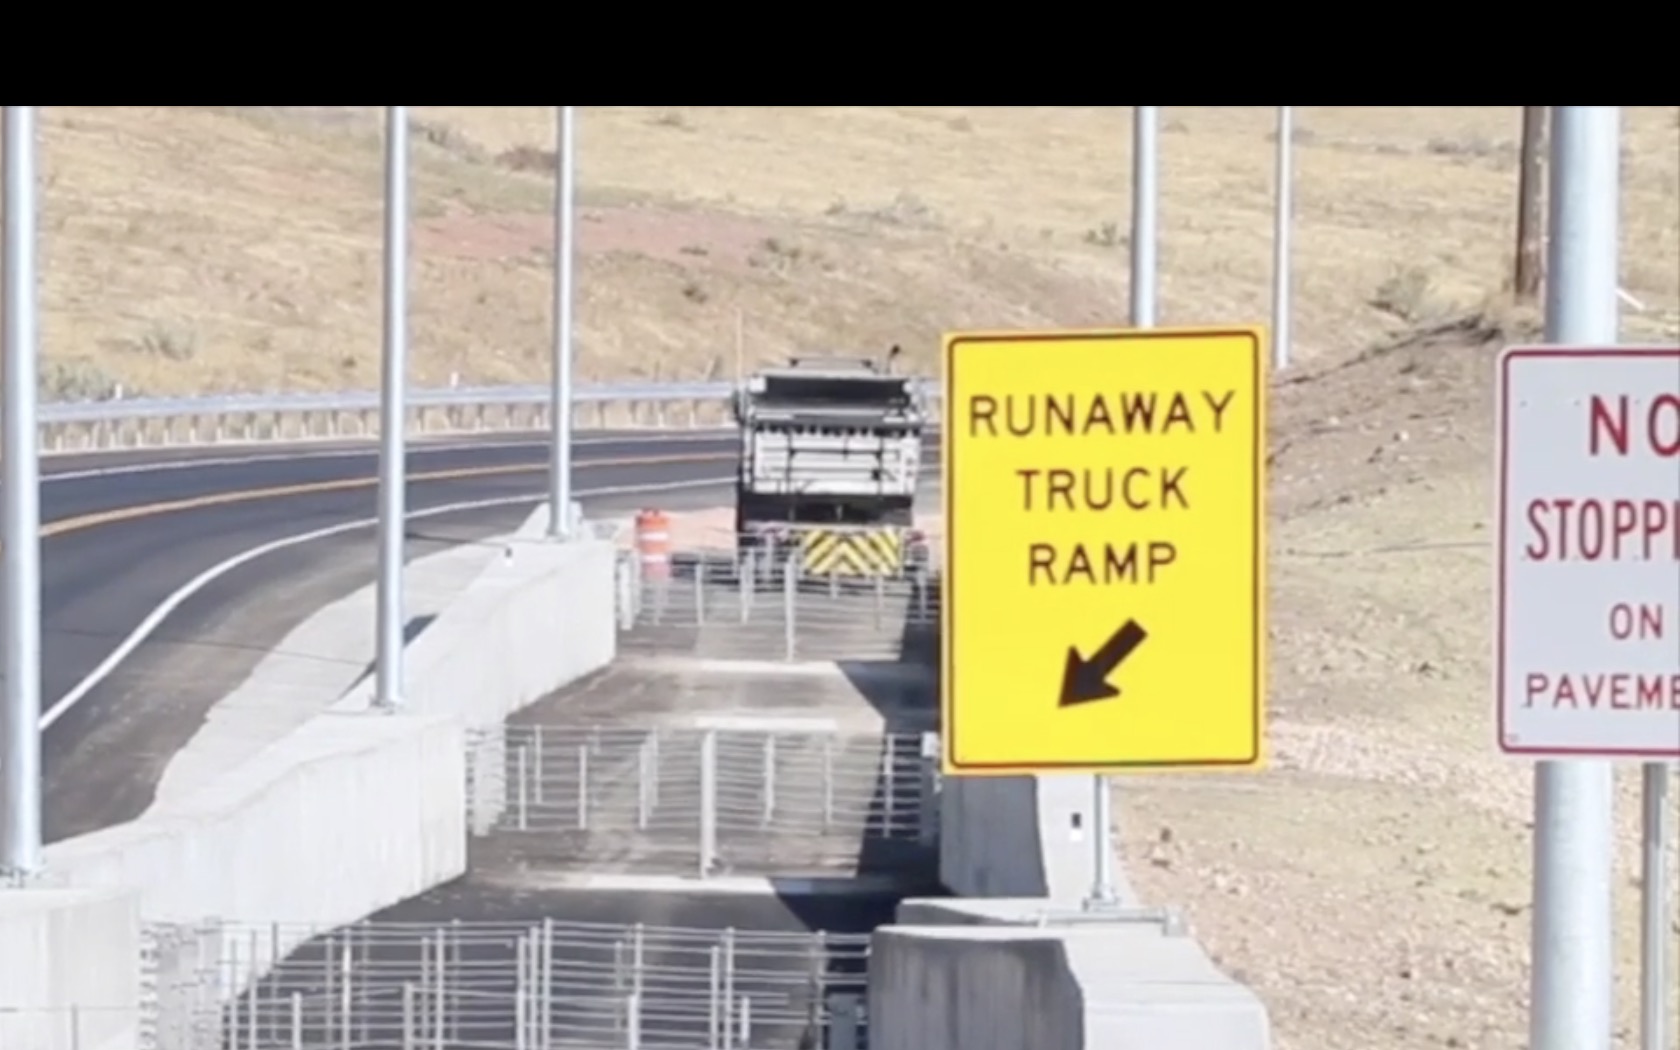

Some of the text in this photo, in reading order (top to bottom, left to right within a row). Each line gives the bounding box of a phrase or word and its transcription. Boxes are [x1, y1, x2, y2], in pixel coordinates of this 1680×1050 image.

[970, 391, 1235, 437] RUNAWAY
[1589, 393, 1680, 457] NO
[1016, 467, 1189, 511] TRUCK
[1029, 542, 1177, 585] RAMP
[1609, 603, 1663, 639] ON
